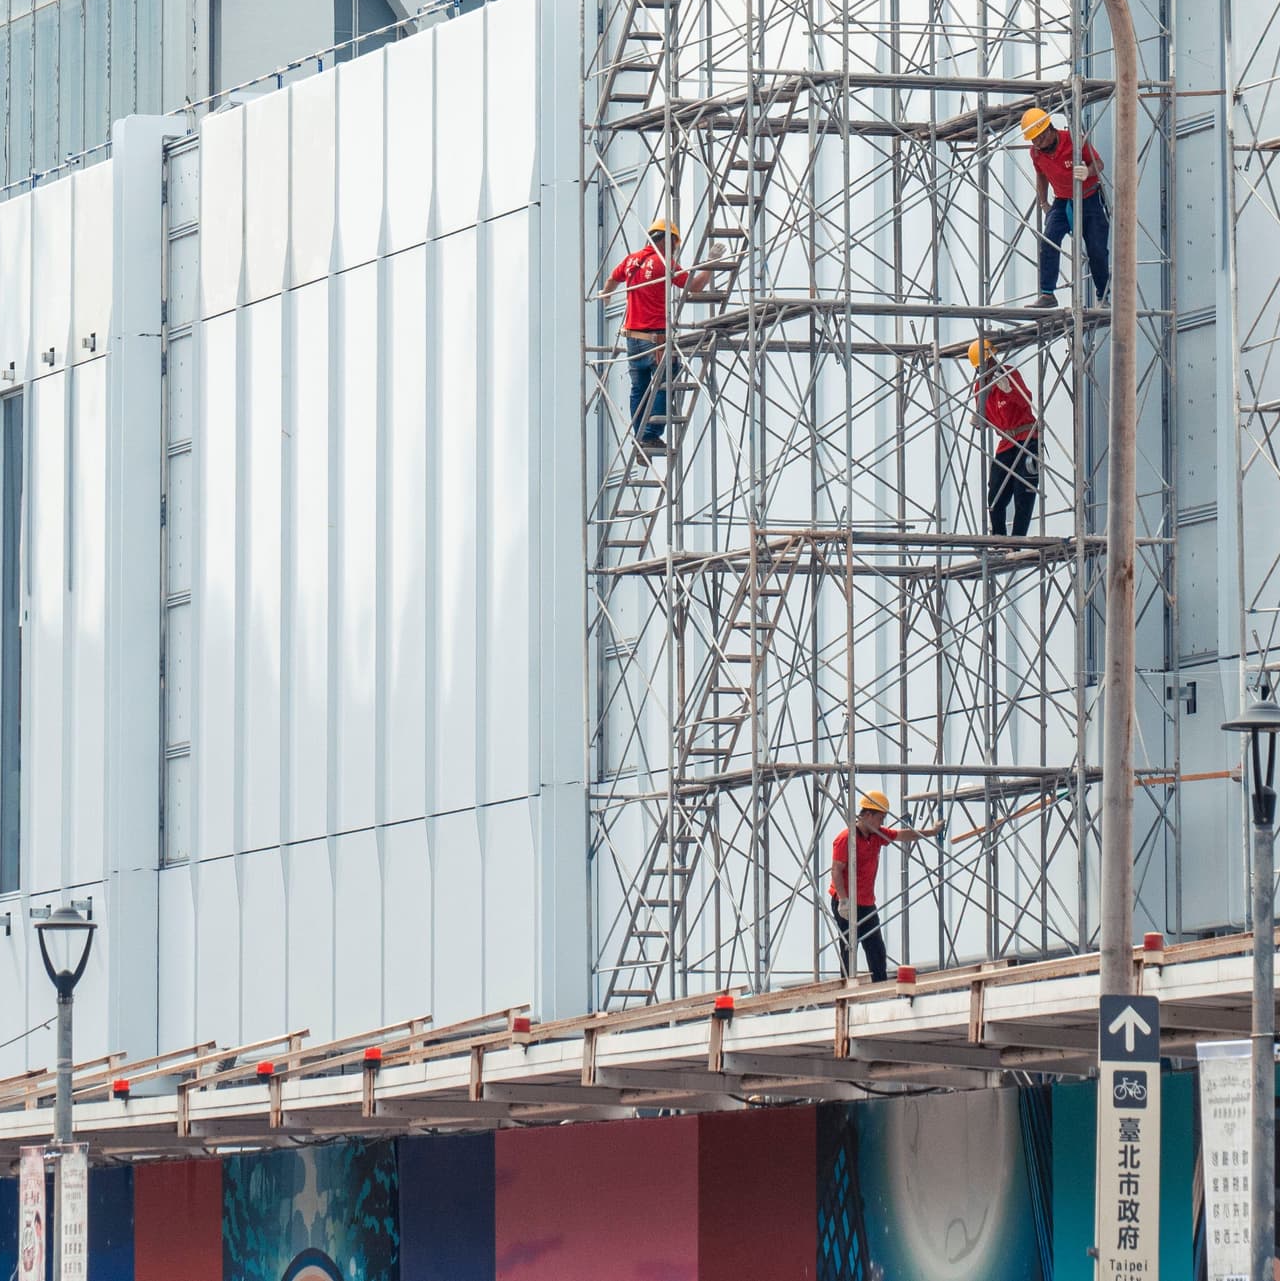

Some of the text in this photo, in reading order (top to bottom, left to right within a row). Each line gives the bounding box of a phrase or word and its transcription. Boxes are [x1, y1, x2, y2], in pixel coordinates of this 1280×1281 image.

[1117, 1117, 1141, 1251] 臺北市政府
[1109, 1259, 1148, 1272] Taipei
